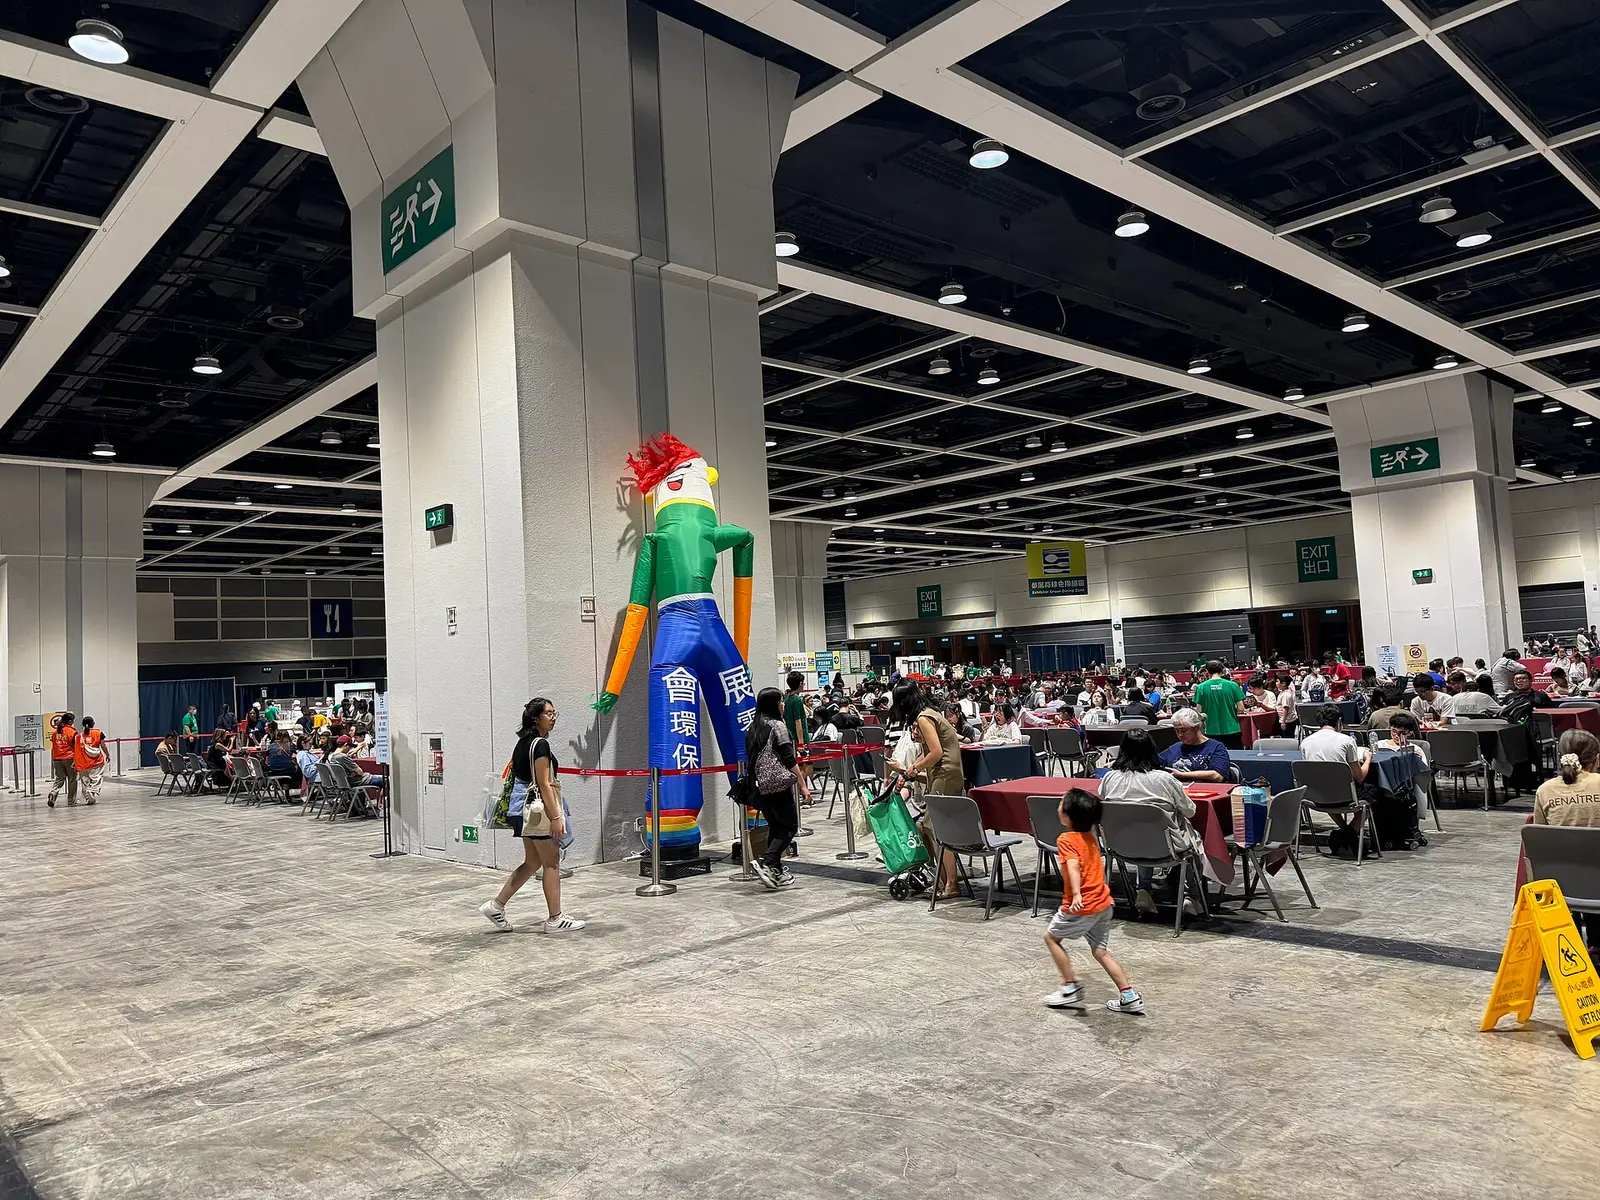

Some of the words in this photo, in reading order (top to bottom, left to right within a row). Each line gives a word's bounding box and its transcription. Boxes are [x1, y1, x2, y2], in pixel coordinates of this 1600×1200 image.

[1301, 545, 1330, 559] EXIT
[1303, 560, 1330, 575] 出口
[920, 590, 937, 601] EXIT
[922, 602, 938, 612] 出口
[1548, 794, 1600, 807] RENAÎTRE
[1576, 993, 1600, 1010] CAUTION
[1579, 1012, 1592, 1026] WET
